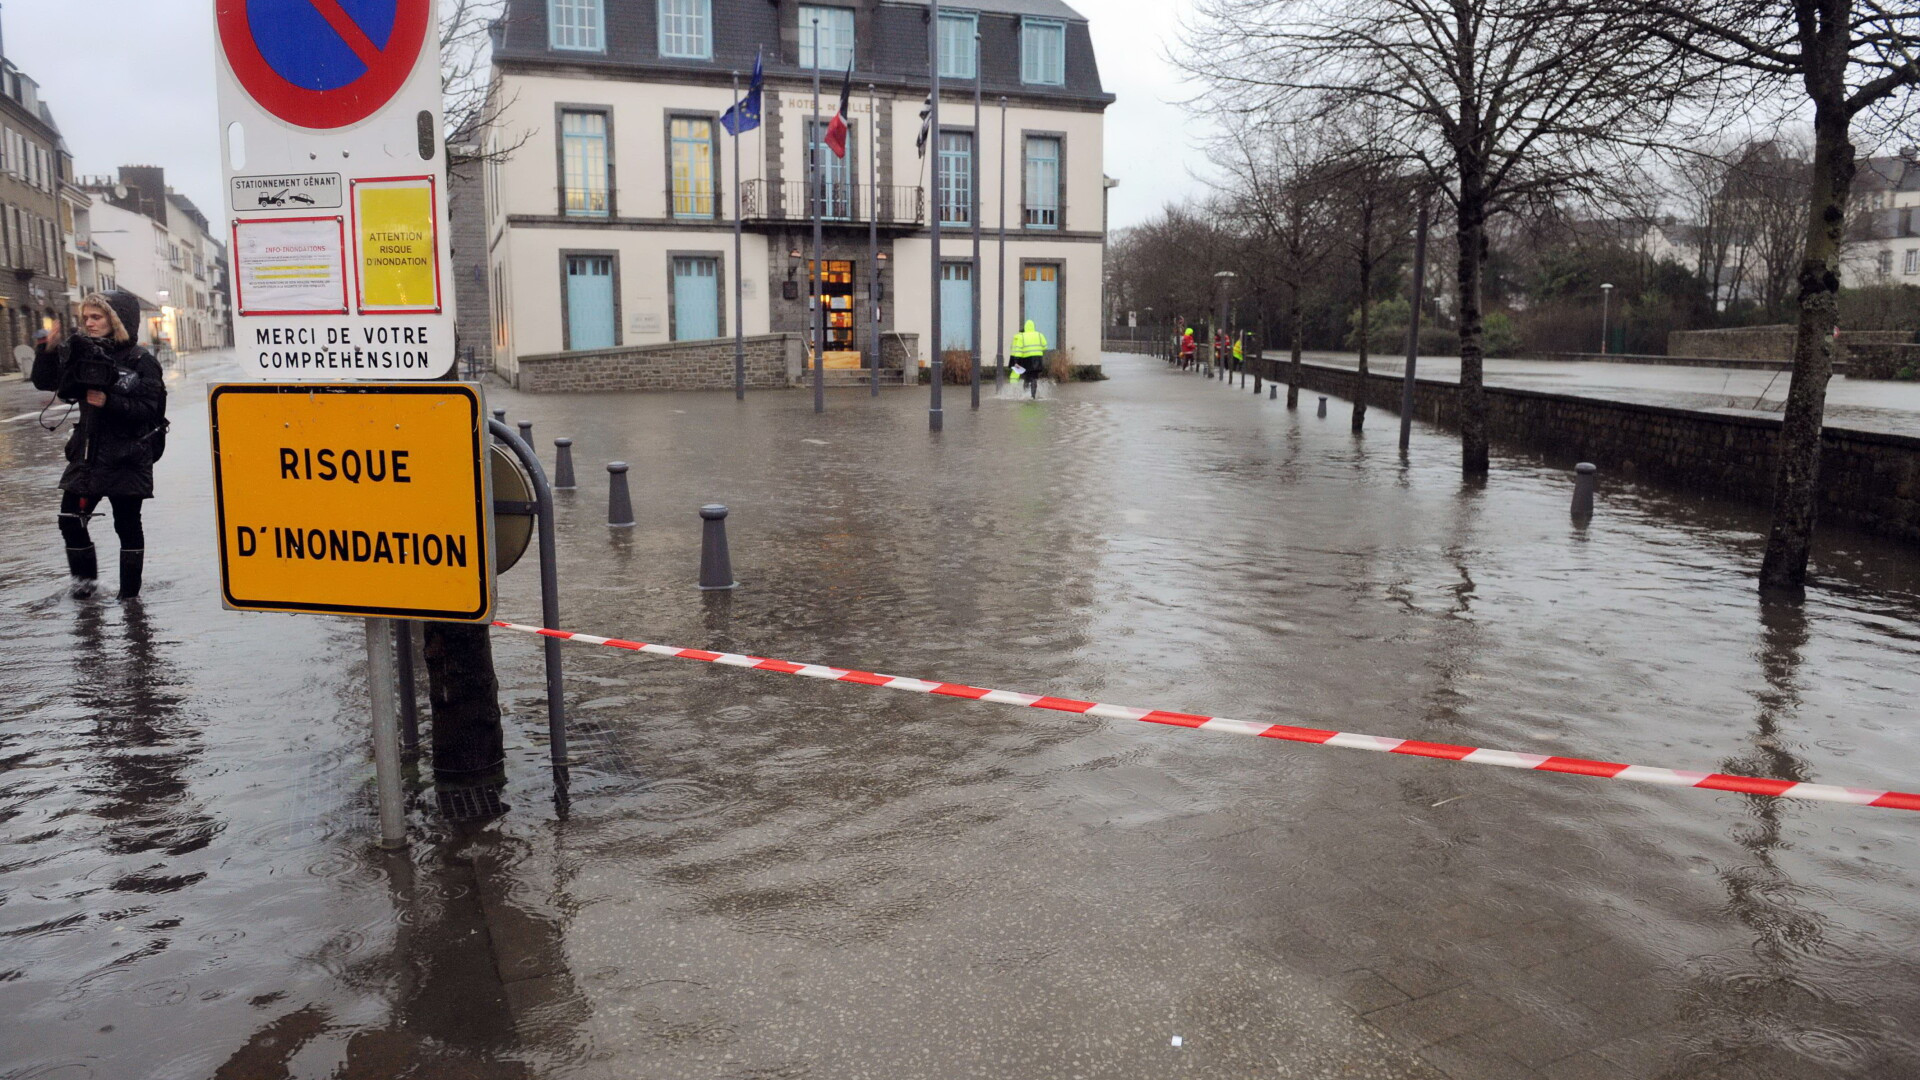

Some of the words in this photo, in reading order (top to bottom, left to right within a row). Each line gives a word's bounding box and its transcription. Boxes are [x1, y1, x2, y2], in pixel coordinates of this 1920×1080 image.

[236, 178, 300, 189] STATIONNEMENT
[303, 175, 336, 187] GÊNANT
[369, 232, 423, 241] ATTENTION
[265, 245, 326, 253] INFO-INONDATIONS
[380, 245, 412, 254] RISQUE
[366, 257, 427, 266] D'INONDATION
[256, 328, 316, 345] MERCI
[327, 328, 350, 345] DE
[363, 327, 428, 344] VOTRE
[259, 351, 429, 368] COMPREHENSION
[279, 447, 411, 483] RISQUE
